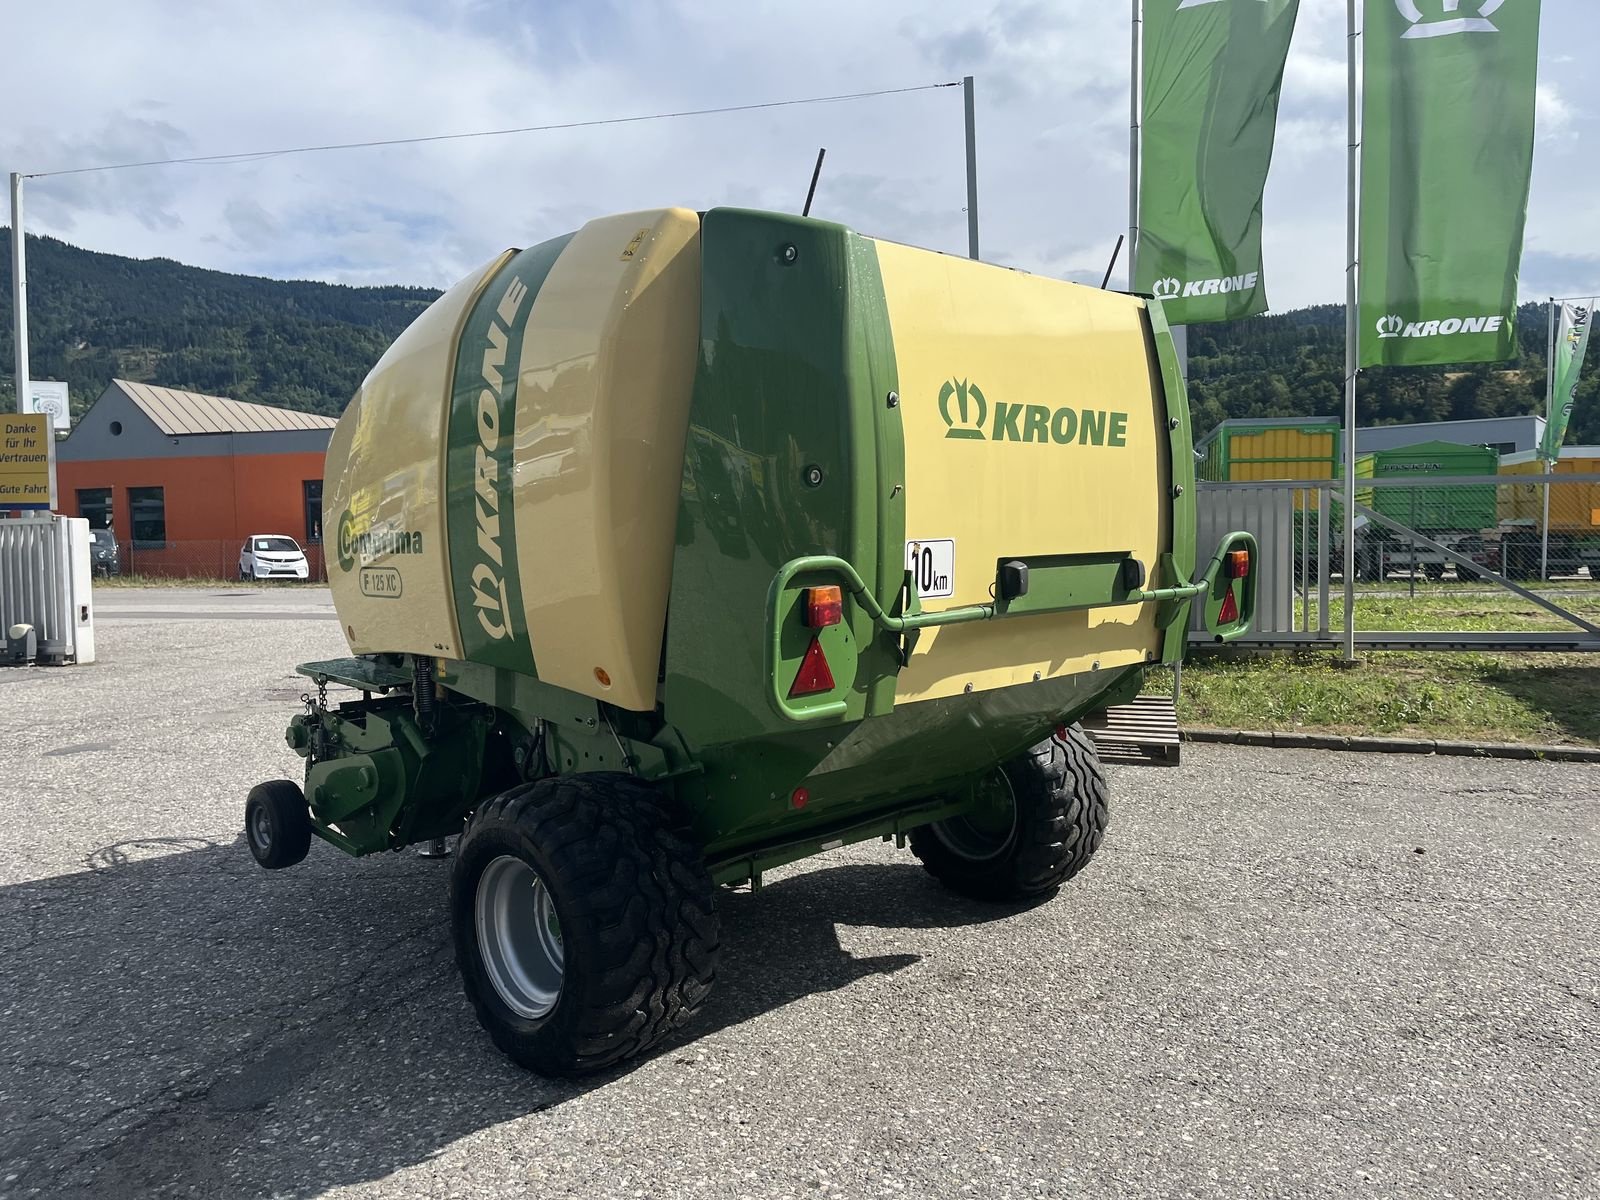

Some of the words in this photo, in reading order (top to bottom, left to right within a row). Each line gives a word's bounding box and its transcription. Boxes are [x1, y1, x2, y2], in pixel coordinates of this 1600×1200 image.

[1181, 271, 1258, 297] KRONE
[1401, 315, 1505, 338] KRONE
[5, 424, 37, 434] Danke
[474, 275, 529, 568] KRONE
[991, 401, 1128, 447] KRONE
[5, 438, 20, 449] für
[23, 438, 36, 448] Ihr
[0, 453, 47, 462] Vertrauen
[0, 484, 20, 494] Gute
[24, 484, 47, 494] Fahrt
[911, 543, 932, 592] 10
[933, 570, 948, 590] km
[363, 573, 369, 590] F
[372, 573, 385, 591] 125
[386, 574, 397, 592] XC
